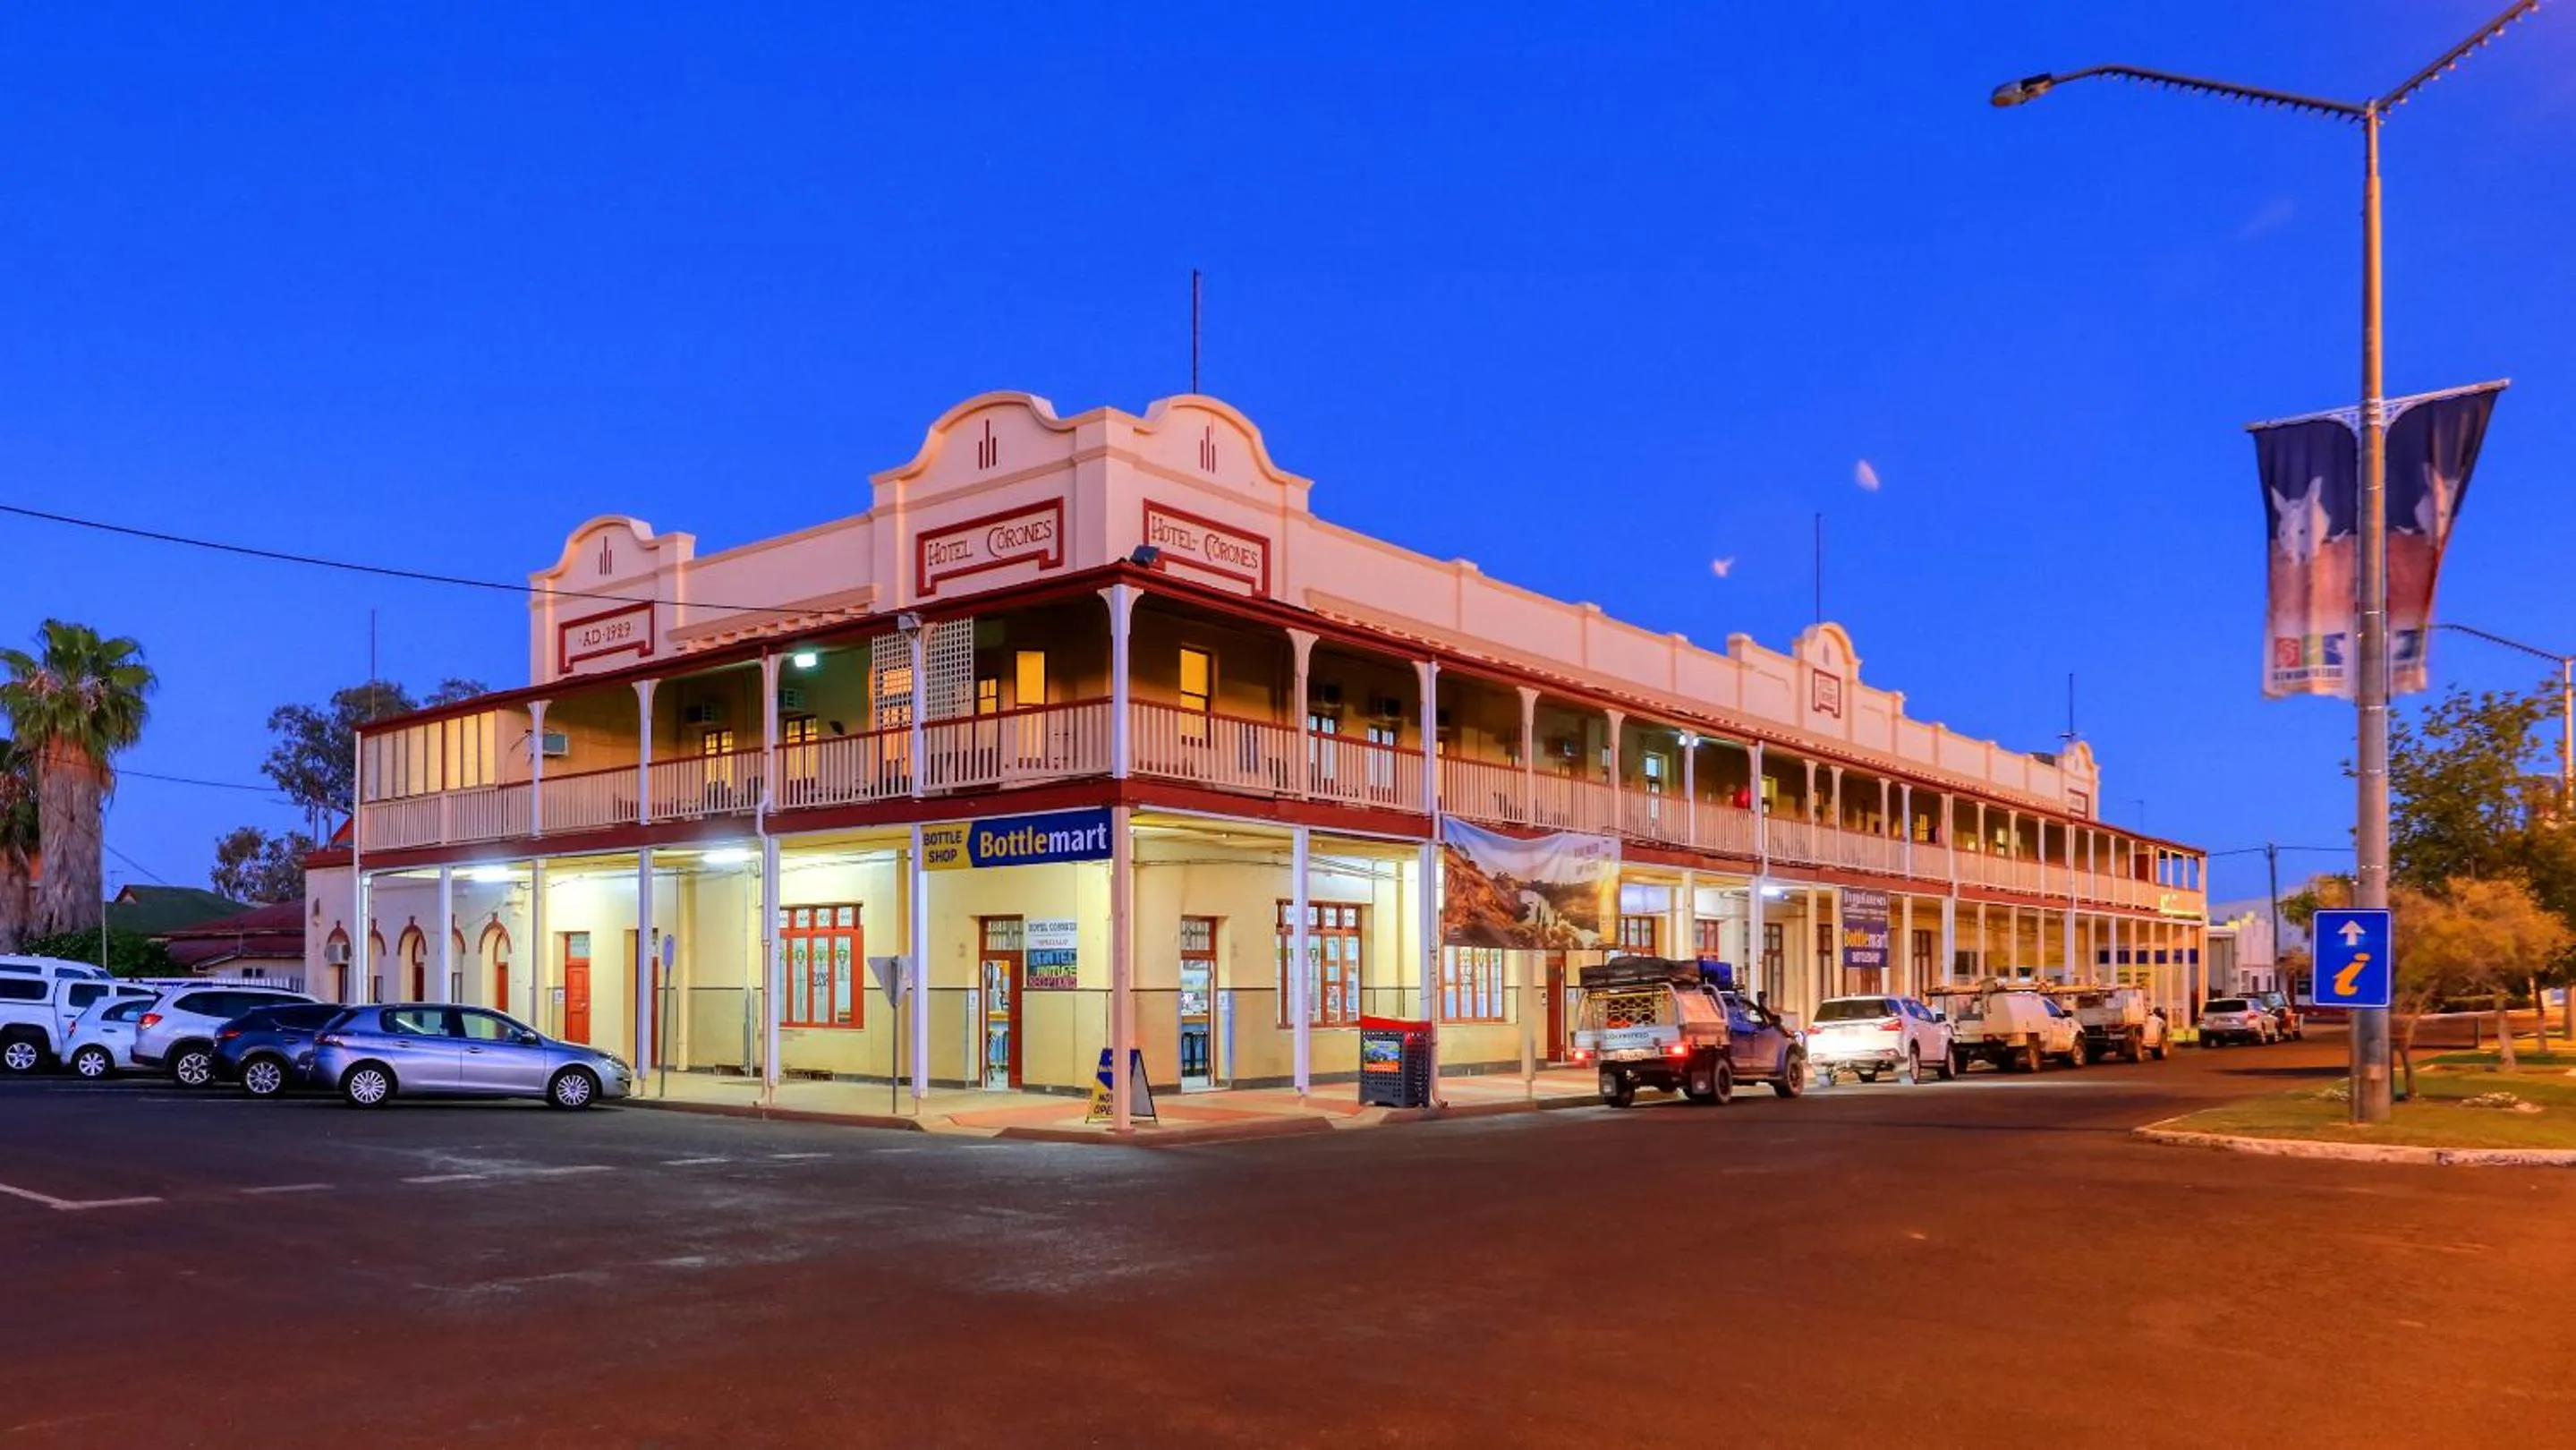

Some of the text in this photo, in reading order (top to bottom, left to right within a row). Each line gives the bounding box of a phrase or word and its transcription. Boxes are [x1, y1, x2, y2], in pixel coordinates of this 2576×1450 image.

[928, 519, 1052, 567] HOTEL CORONES
[1151, 515, 1258, 570] HOTEL CORONES
[922, 830, 963, 847] BOTTLE
[928, 848, 957, 864] SHOP
[979, 822, 1108, 858] Bottlemart
